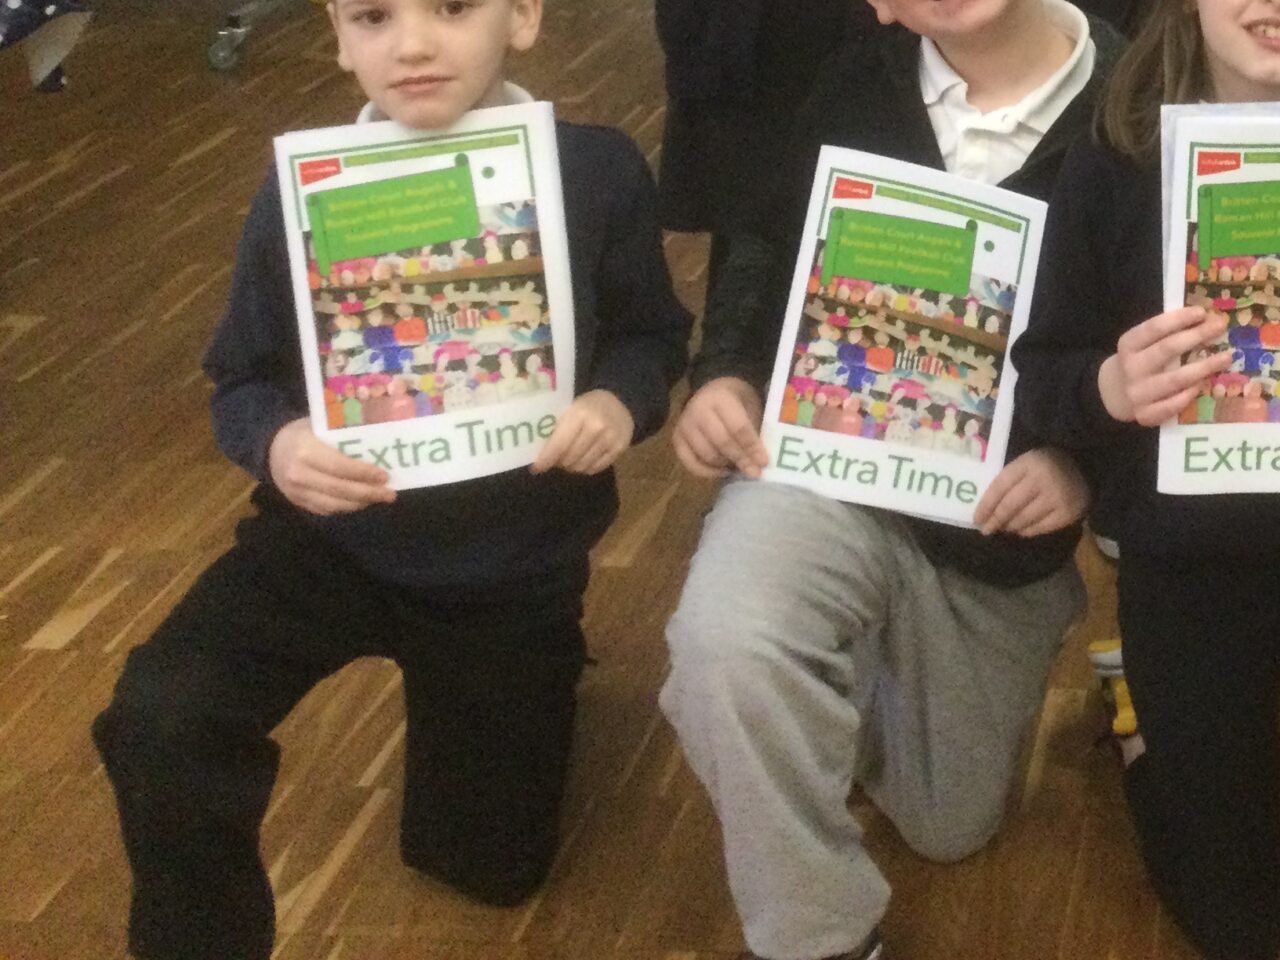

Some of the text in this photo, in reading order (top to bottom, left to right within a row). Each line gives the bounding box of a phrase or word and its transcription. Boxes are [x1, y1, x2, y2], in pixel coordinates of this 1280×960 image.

[455, 413, 556, 456] Time
[776, 436, 978, 504] Extra Time
